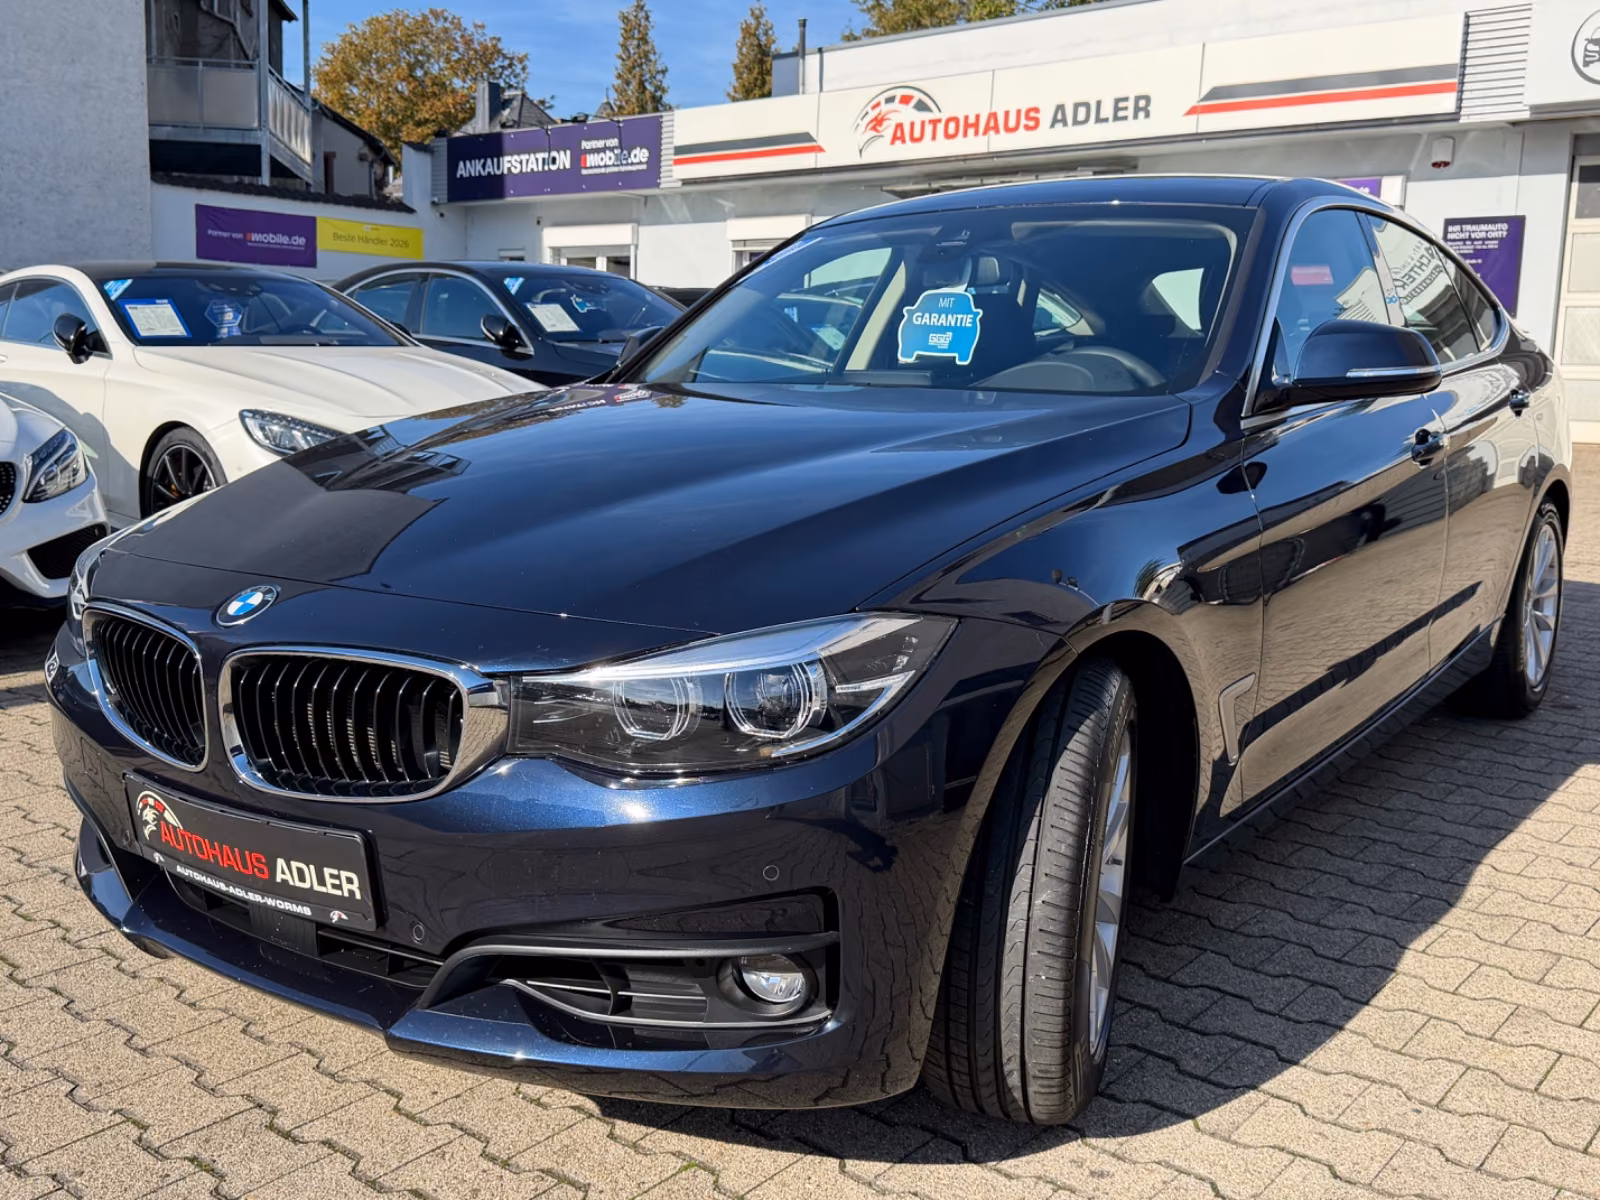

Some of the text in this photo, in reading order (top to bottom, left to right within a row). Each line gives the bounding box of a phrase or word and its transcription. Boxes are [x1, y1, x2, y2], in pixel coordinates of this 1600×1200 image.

[889, 94, 1152, 146] AUTOHAUS ADLER
[456, 150, 571, 178] ANKAUFSTATION
[586, 147, 649, 167] mobile.de
[1462, 223, 1508, 231] TRAUMAUTO
[251, 232, 306, 245] mobile.de
[332, 232, 355, 242] Beste
[1447, 232, 1469, 240] NICHT
[1470, 231, 1486, 239] VOR
[938, 297, 955, 308] MIT
[912, 312, 974, 327] GARANTIE
[160, 820, 362, 900] AUTOHAUS ADLER
[176, 864, 312, 916] AUTOHAUS-ADLER-WORMS
